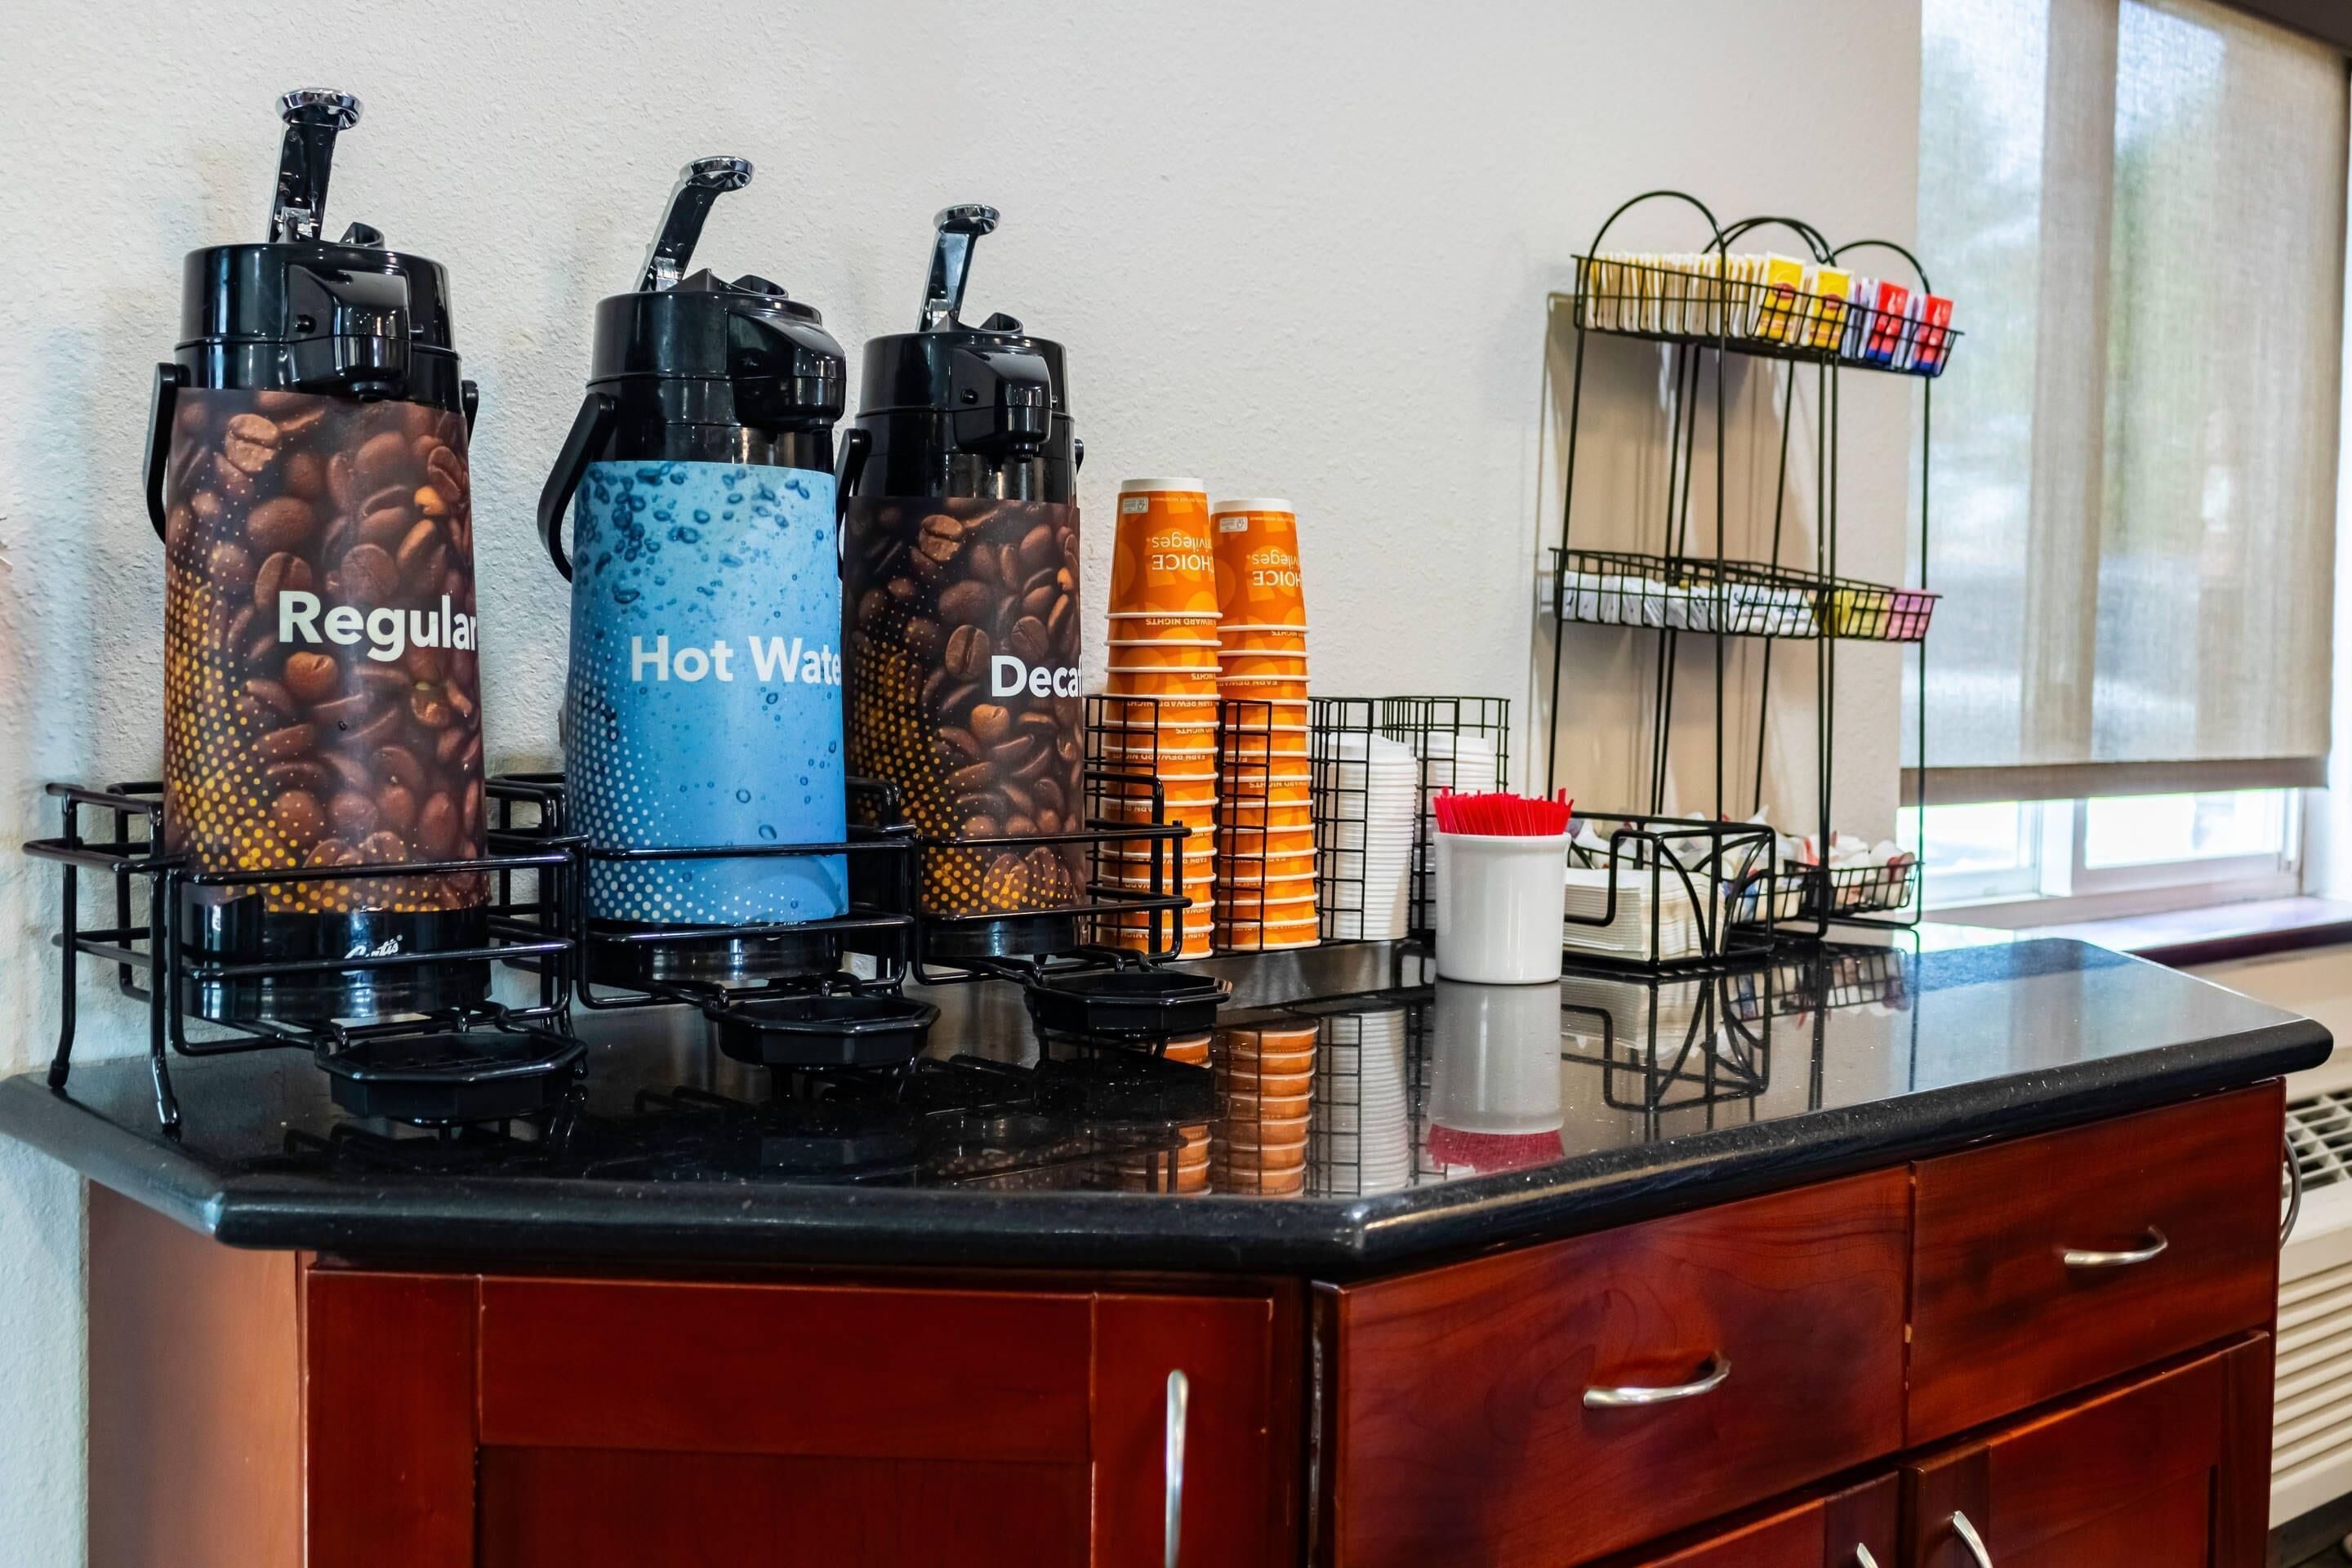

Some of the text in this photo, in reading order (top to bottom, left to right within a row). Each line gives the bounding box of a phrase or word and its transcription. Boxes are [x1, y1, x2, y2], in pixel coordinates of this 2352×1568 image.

[278, 590, 477, 662] Regular
[1145, 617, 1181, 626] NIGHTS
[630, 635, 734, 683] Hot
[341, 937, 399, 977] Crtis
